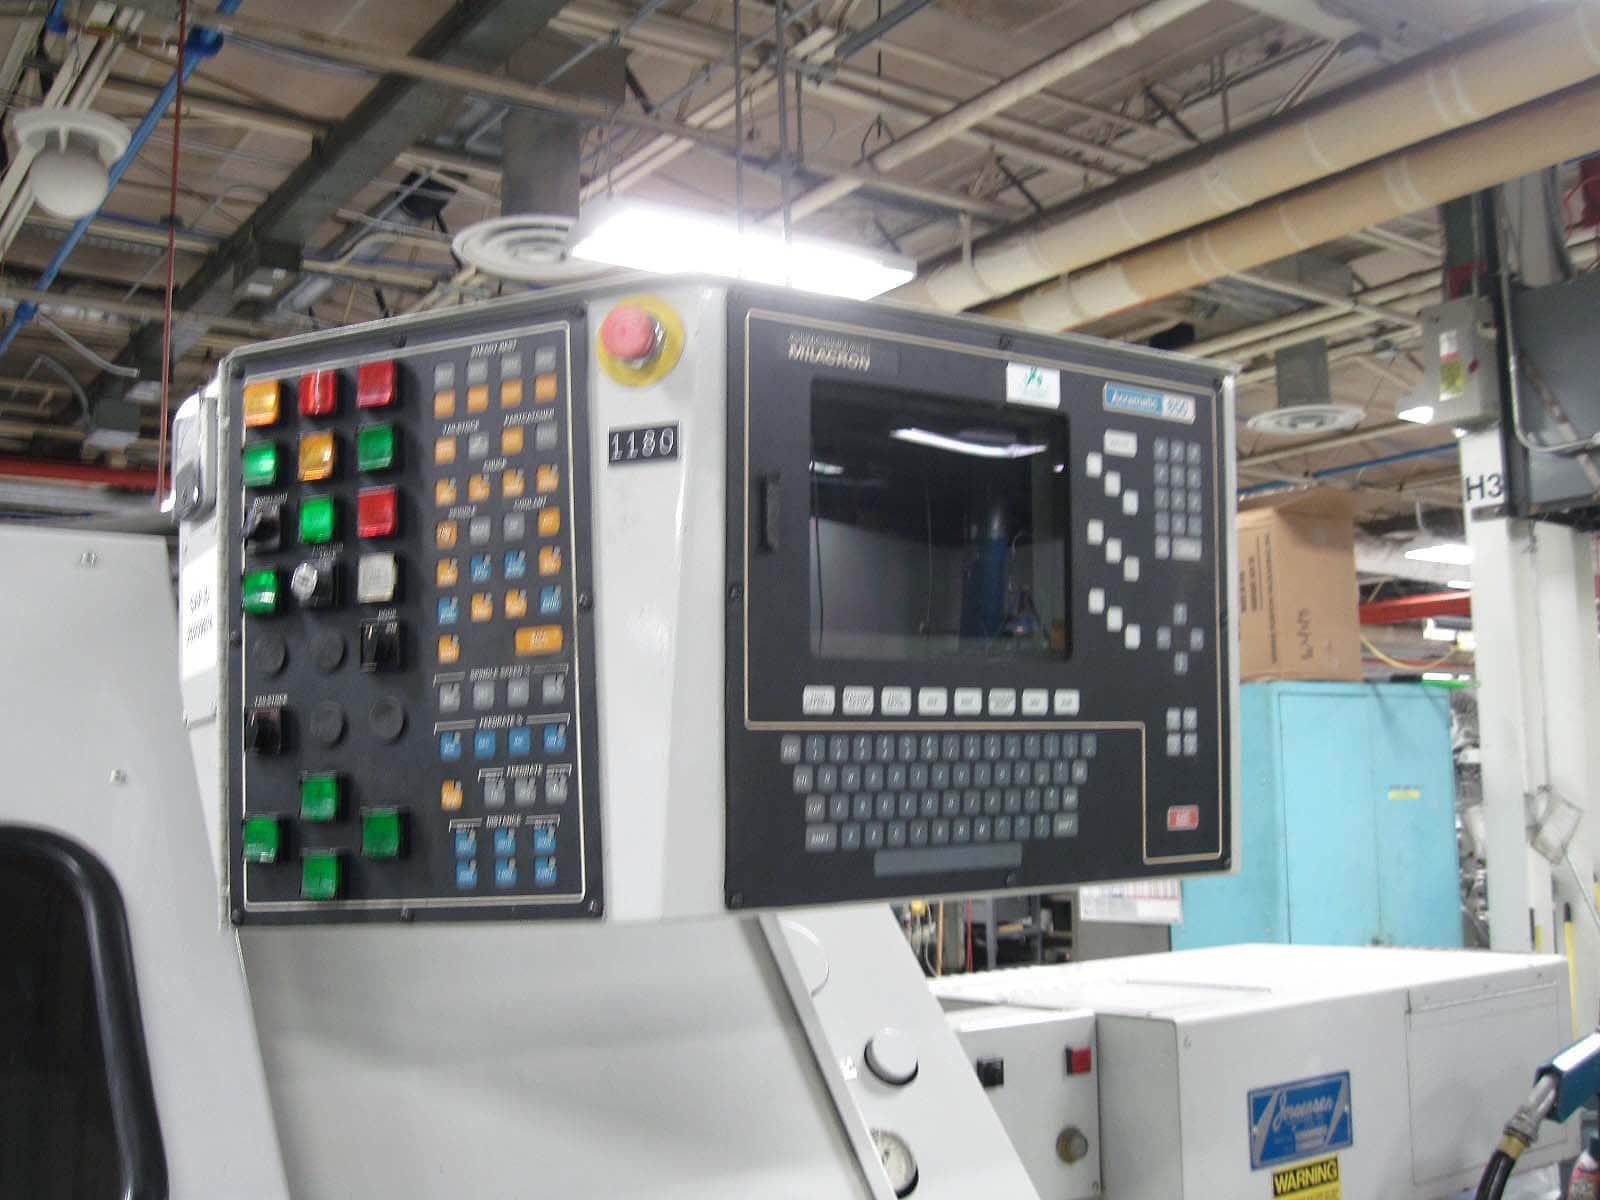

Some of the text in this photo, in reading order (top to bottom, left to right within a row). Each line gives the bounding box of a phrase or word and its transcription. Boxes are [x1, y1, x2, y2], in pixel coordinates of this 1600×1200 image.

[787, 343, 871, 371] MILACRON
[1465, 473, 1502, 501] H3
[1274, 1160, 1338, 1194] WARNING
